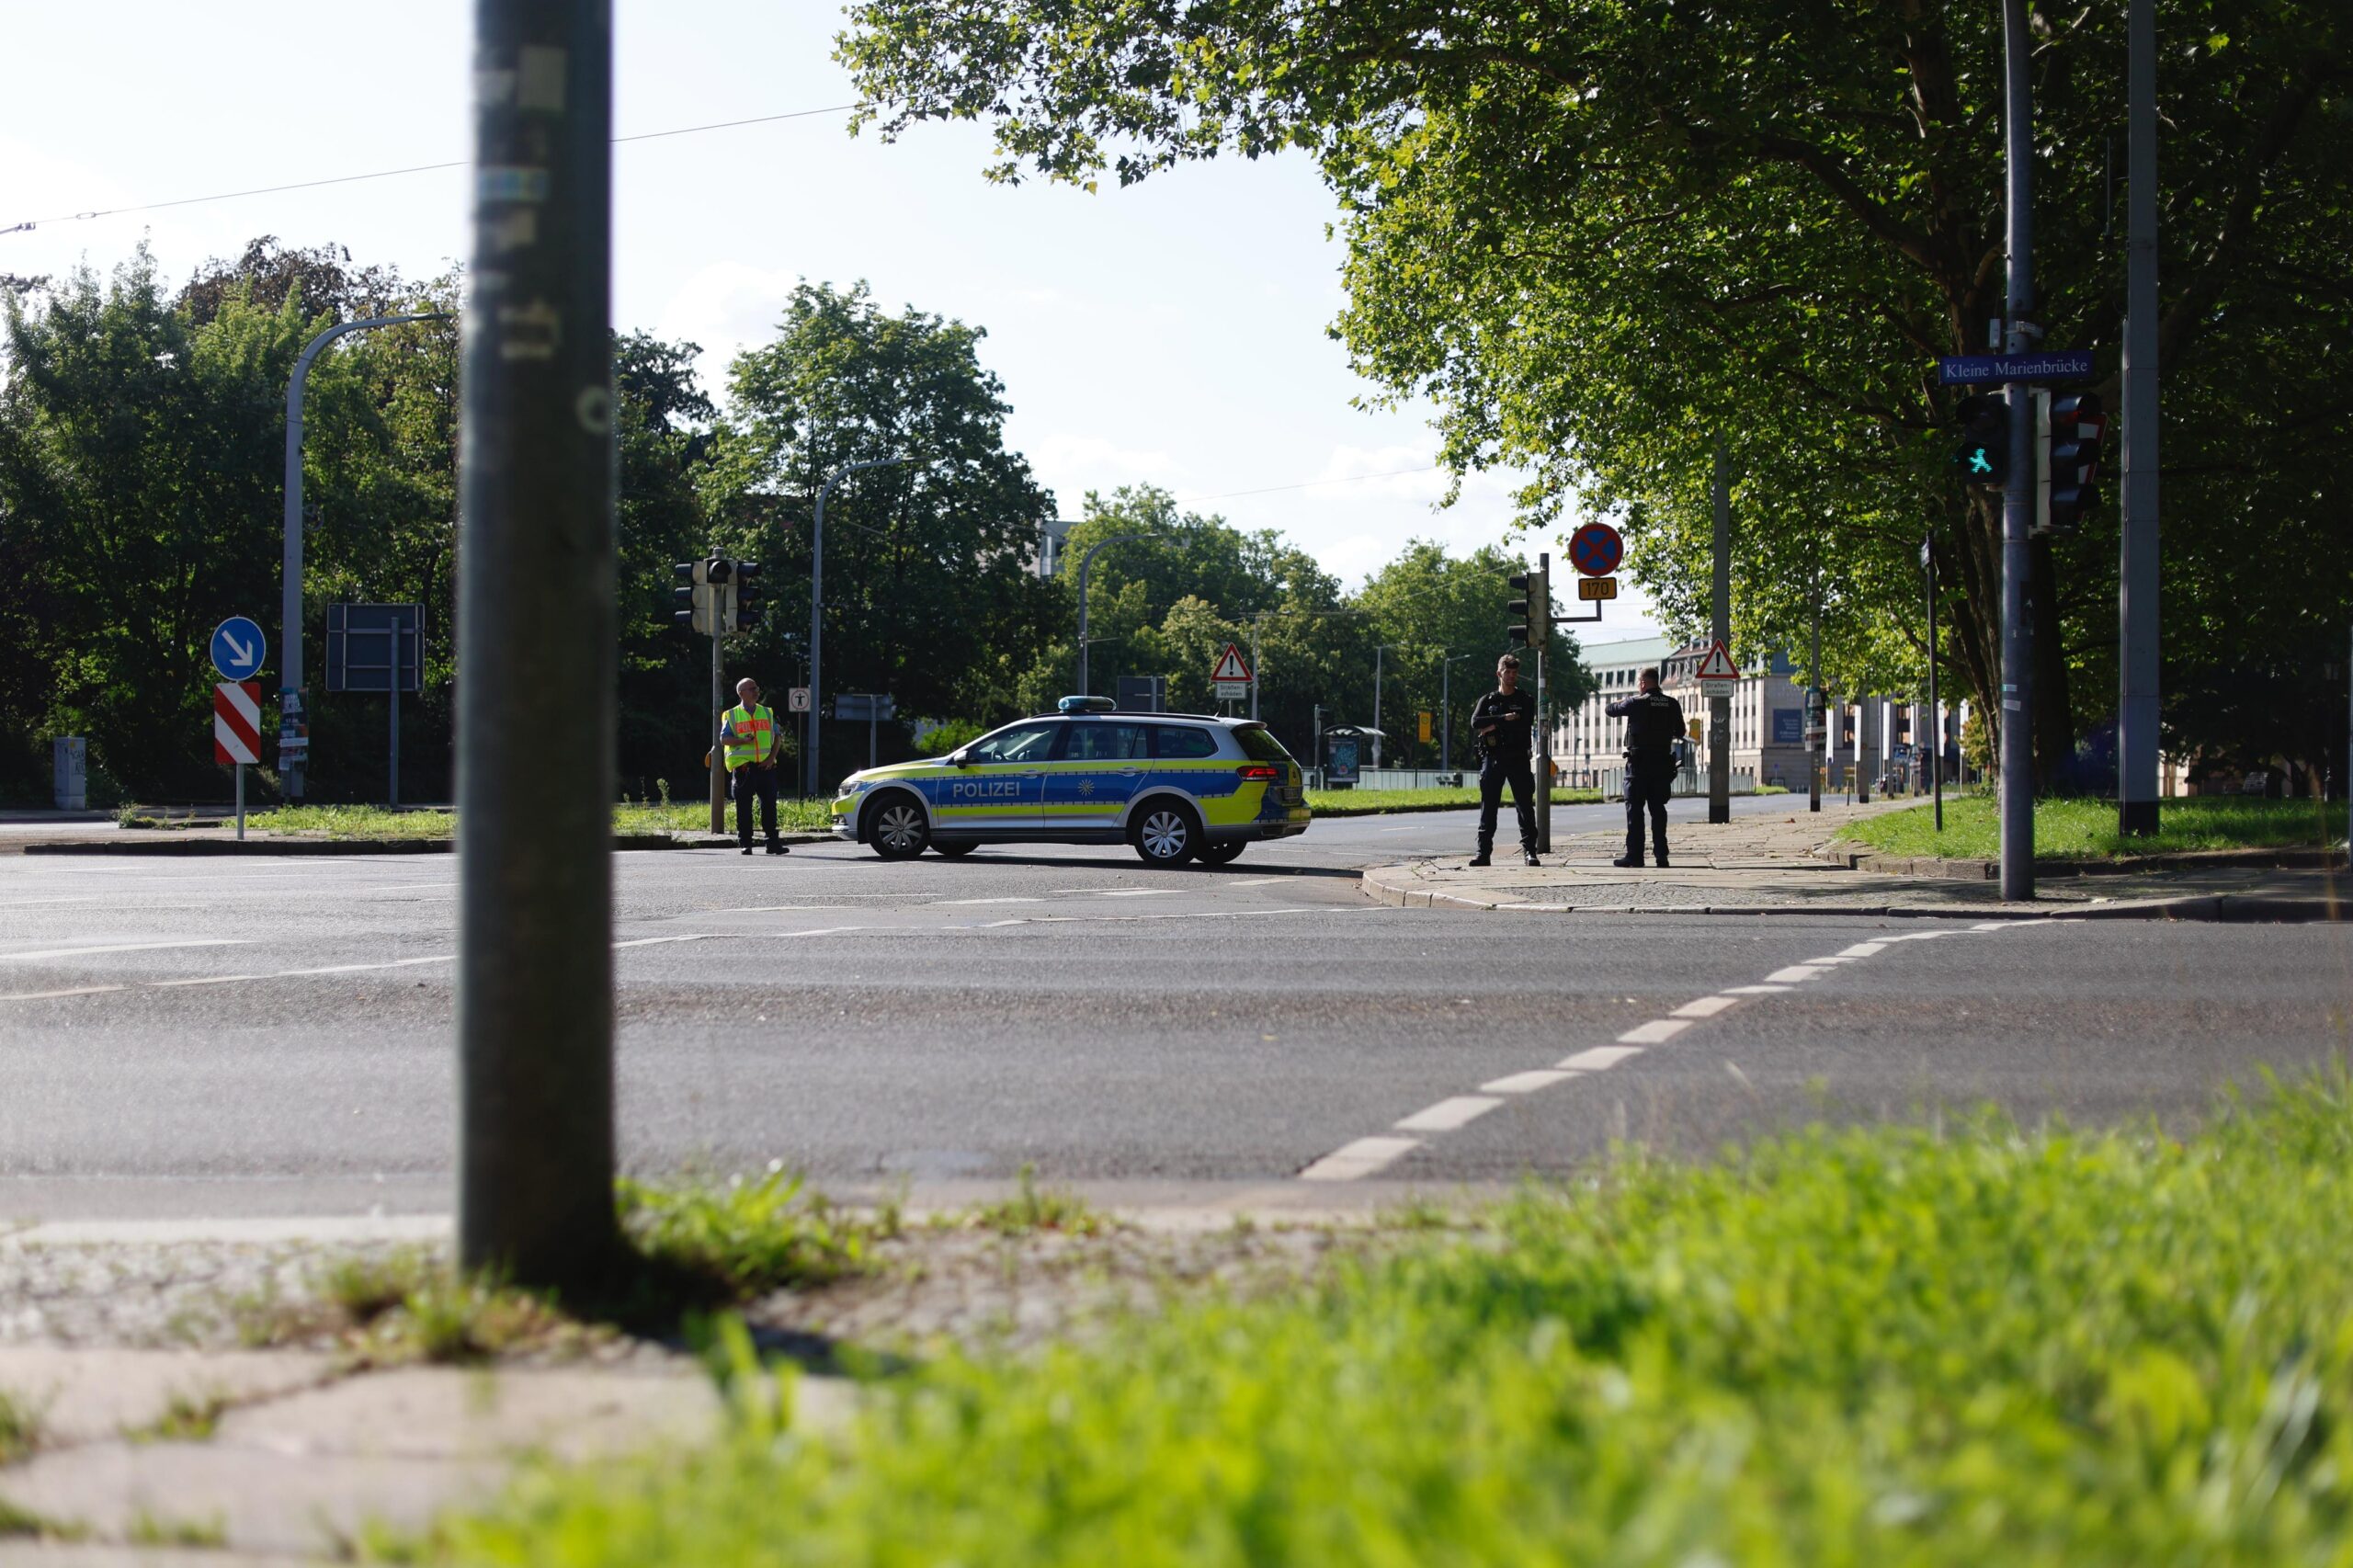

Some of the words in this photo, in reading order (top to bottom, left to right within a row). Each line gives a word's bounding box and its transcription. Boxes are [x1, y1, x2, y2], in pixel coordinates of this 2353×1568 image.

[1946, 363, 1989, 378] Kleine
[1995, 358, 2088, 376] Marienbrücke
[1586, 581, 1609, 597] 170
[952, 781, 1020, 798] POLIZEI
